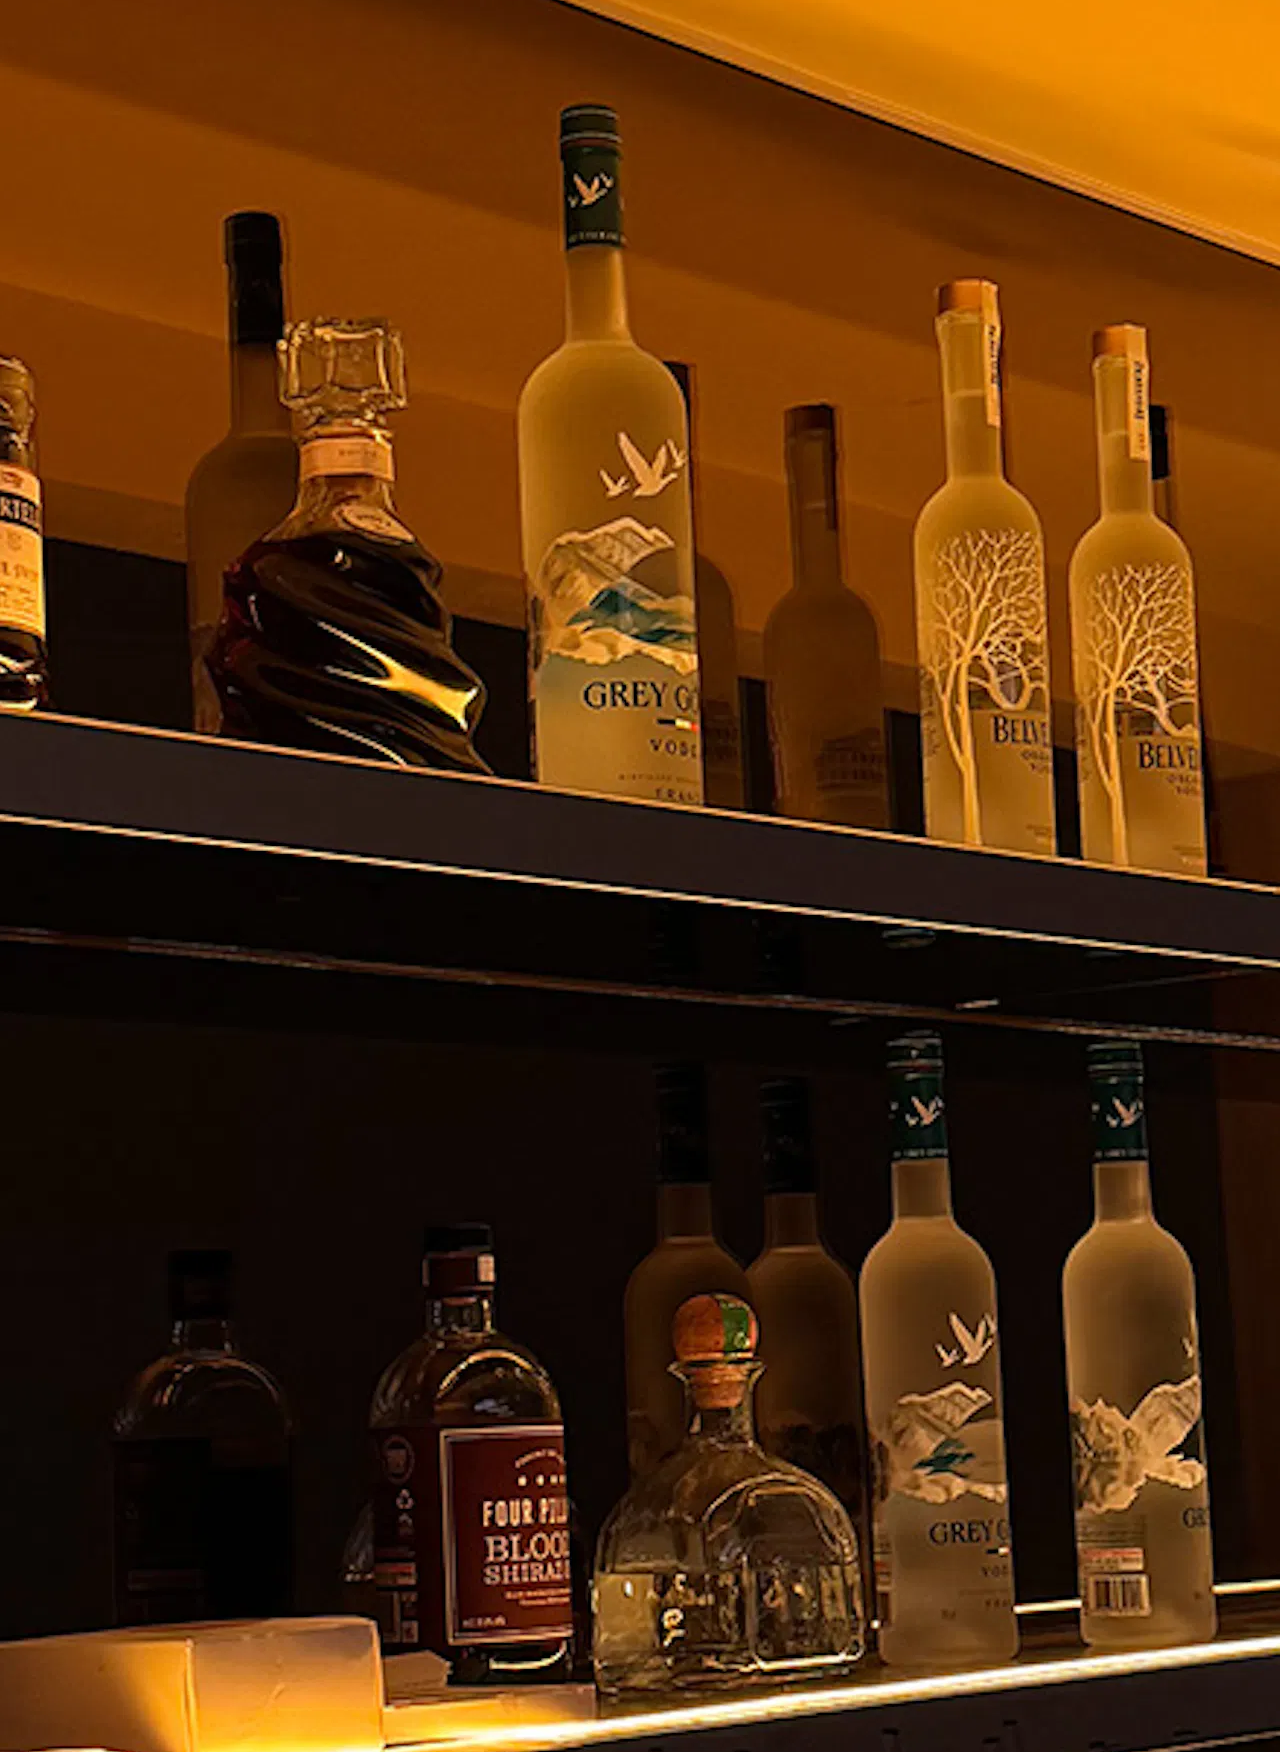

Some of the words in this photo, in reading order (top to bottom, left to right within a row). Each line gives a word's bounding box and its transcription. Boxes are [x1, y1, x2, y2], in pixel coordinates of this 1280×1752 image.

[583, 681, 667, 710] GREY
[482, 1499, 535, 1528] FOUR
[929, 1519, 994, 1545] GREY
